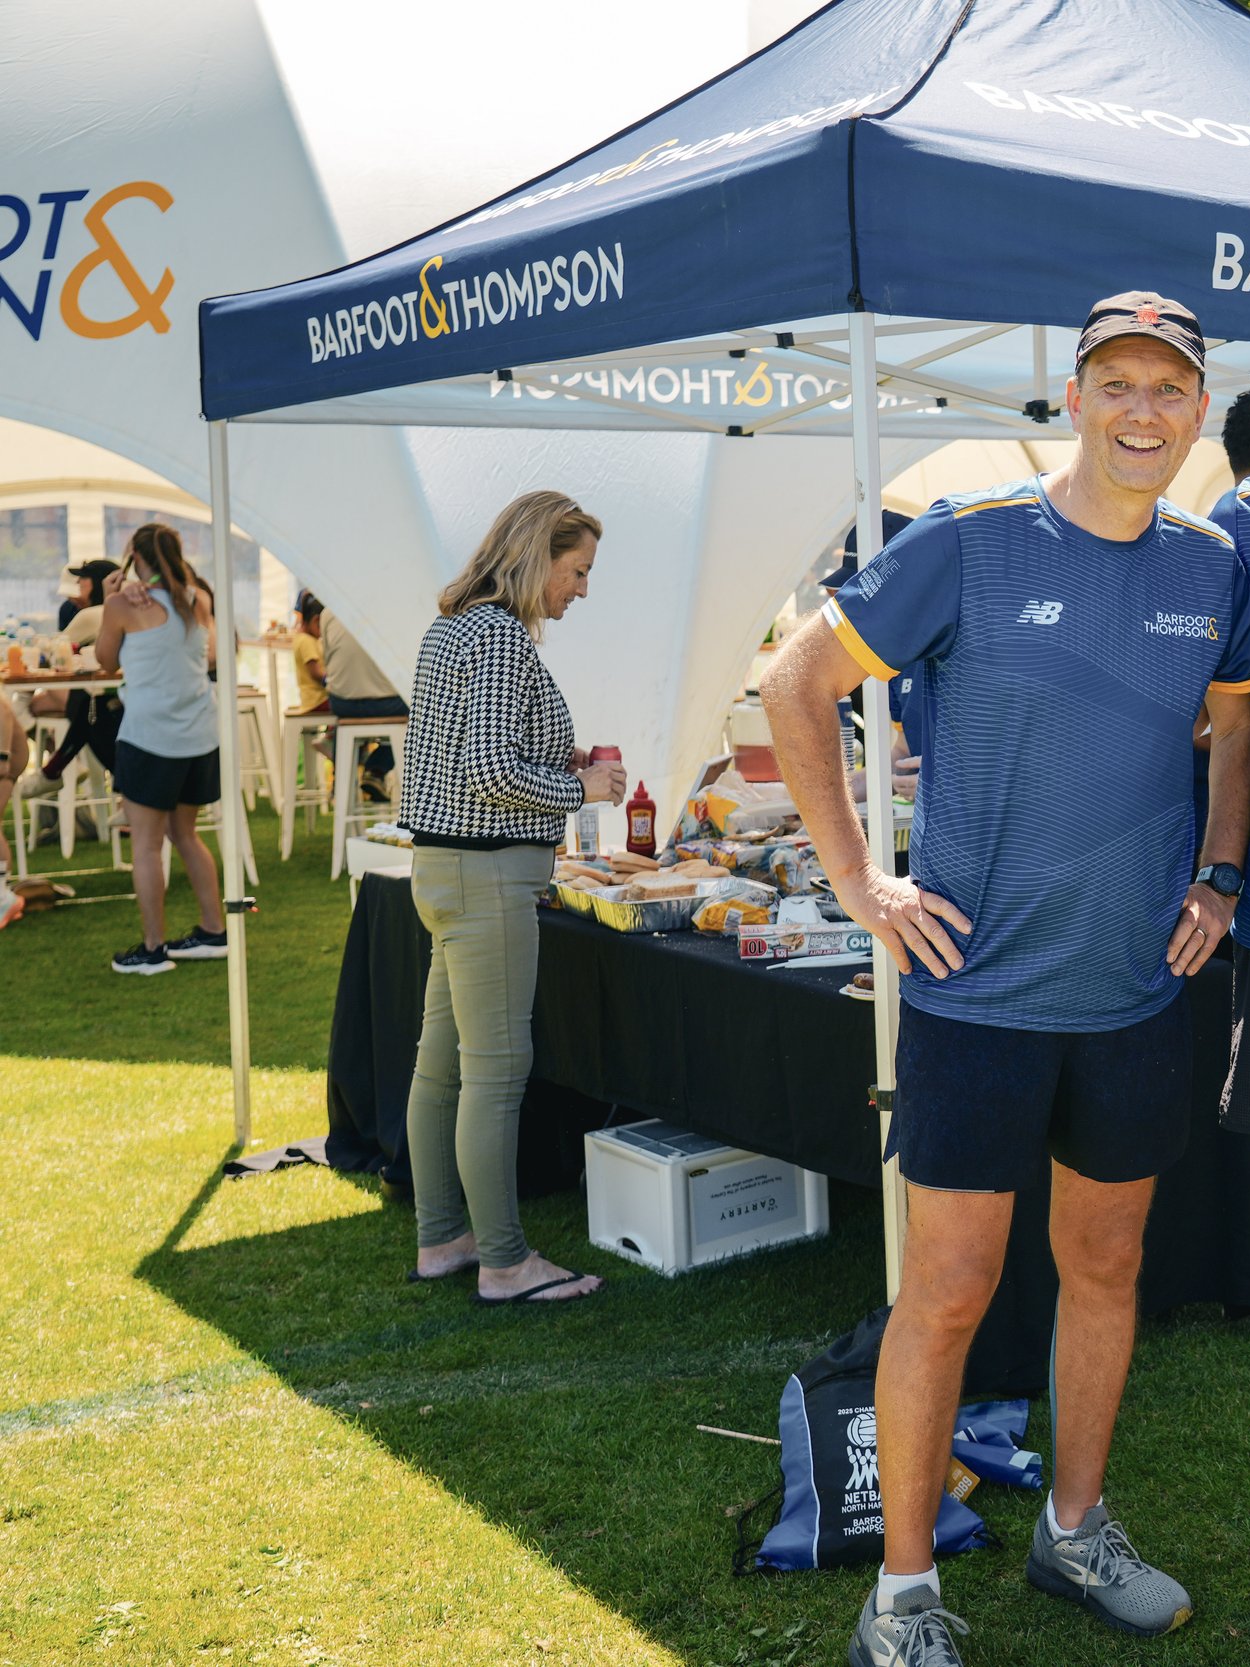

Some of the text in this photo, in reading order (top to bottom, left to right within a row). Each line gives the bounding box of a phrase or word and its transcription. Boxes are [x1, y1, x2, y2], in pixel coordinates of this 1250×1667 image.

[1157, 612, 1209, 627] BARFOOT
[1144, 621, 1208, 638] THOMPSON
[849, 934, 873, 948] no
[720, 1198, 776, 1220] CARTERY
[841, 1502, 866, 1514] NORTH
[853, 1515, 884, 1527] BARFO
